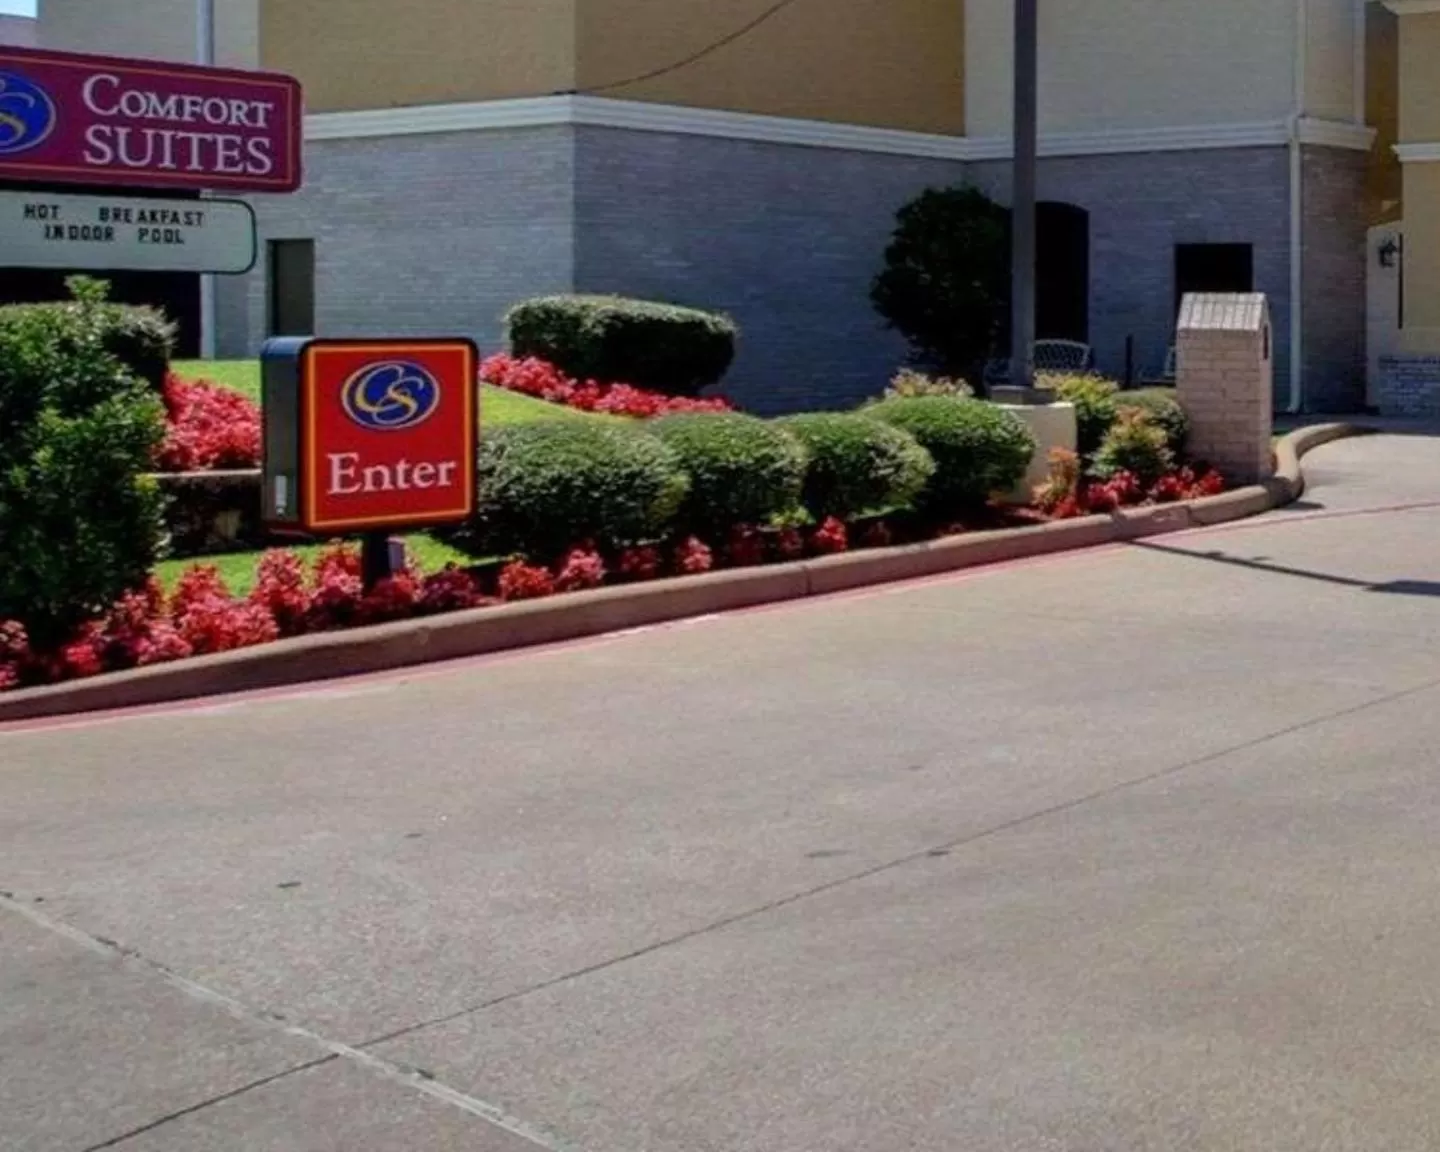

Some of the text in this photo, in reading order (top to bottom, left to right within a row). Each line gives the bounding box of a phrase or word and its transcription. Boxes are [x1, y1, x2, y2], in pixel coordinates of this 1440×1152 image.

[82, 73, 274, 129] COMFORT
[82, 123, 273, 176] SUITES
[23, 203, 205, 227] HOT BREAKFAST
[44, 224, 185, 245] INDOOR POOL
[326, 452, 457, 495] Enter
